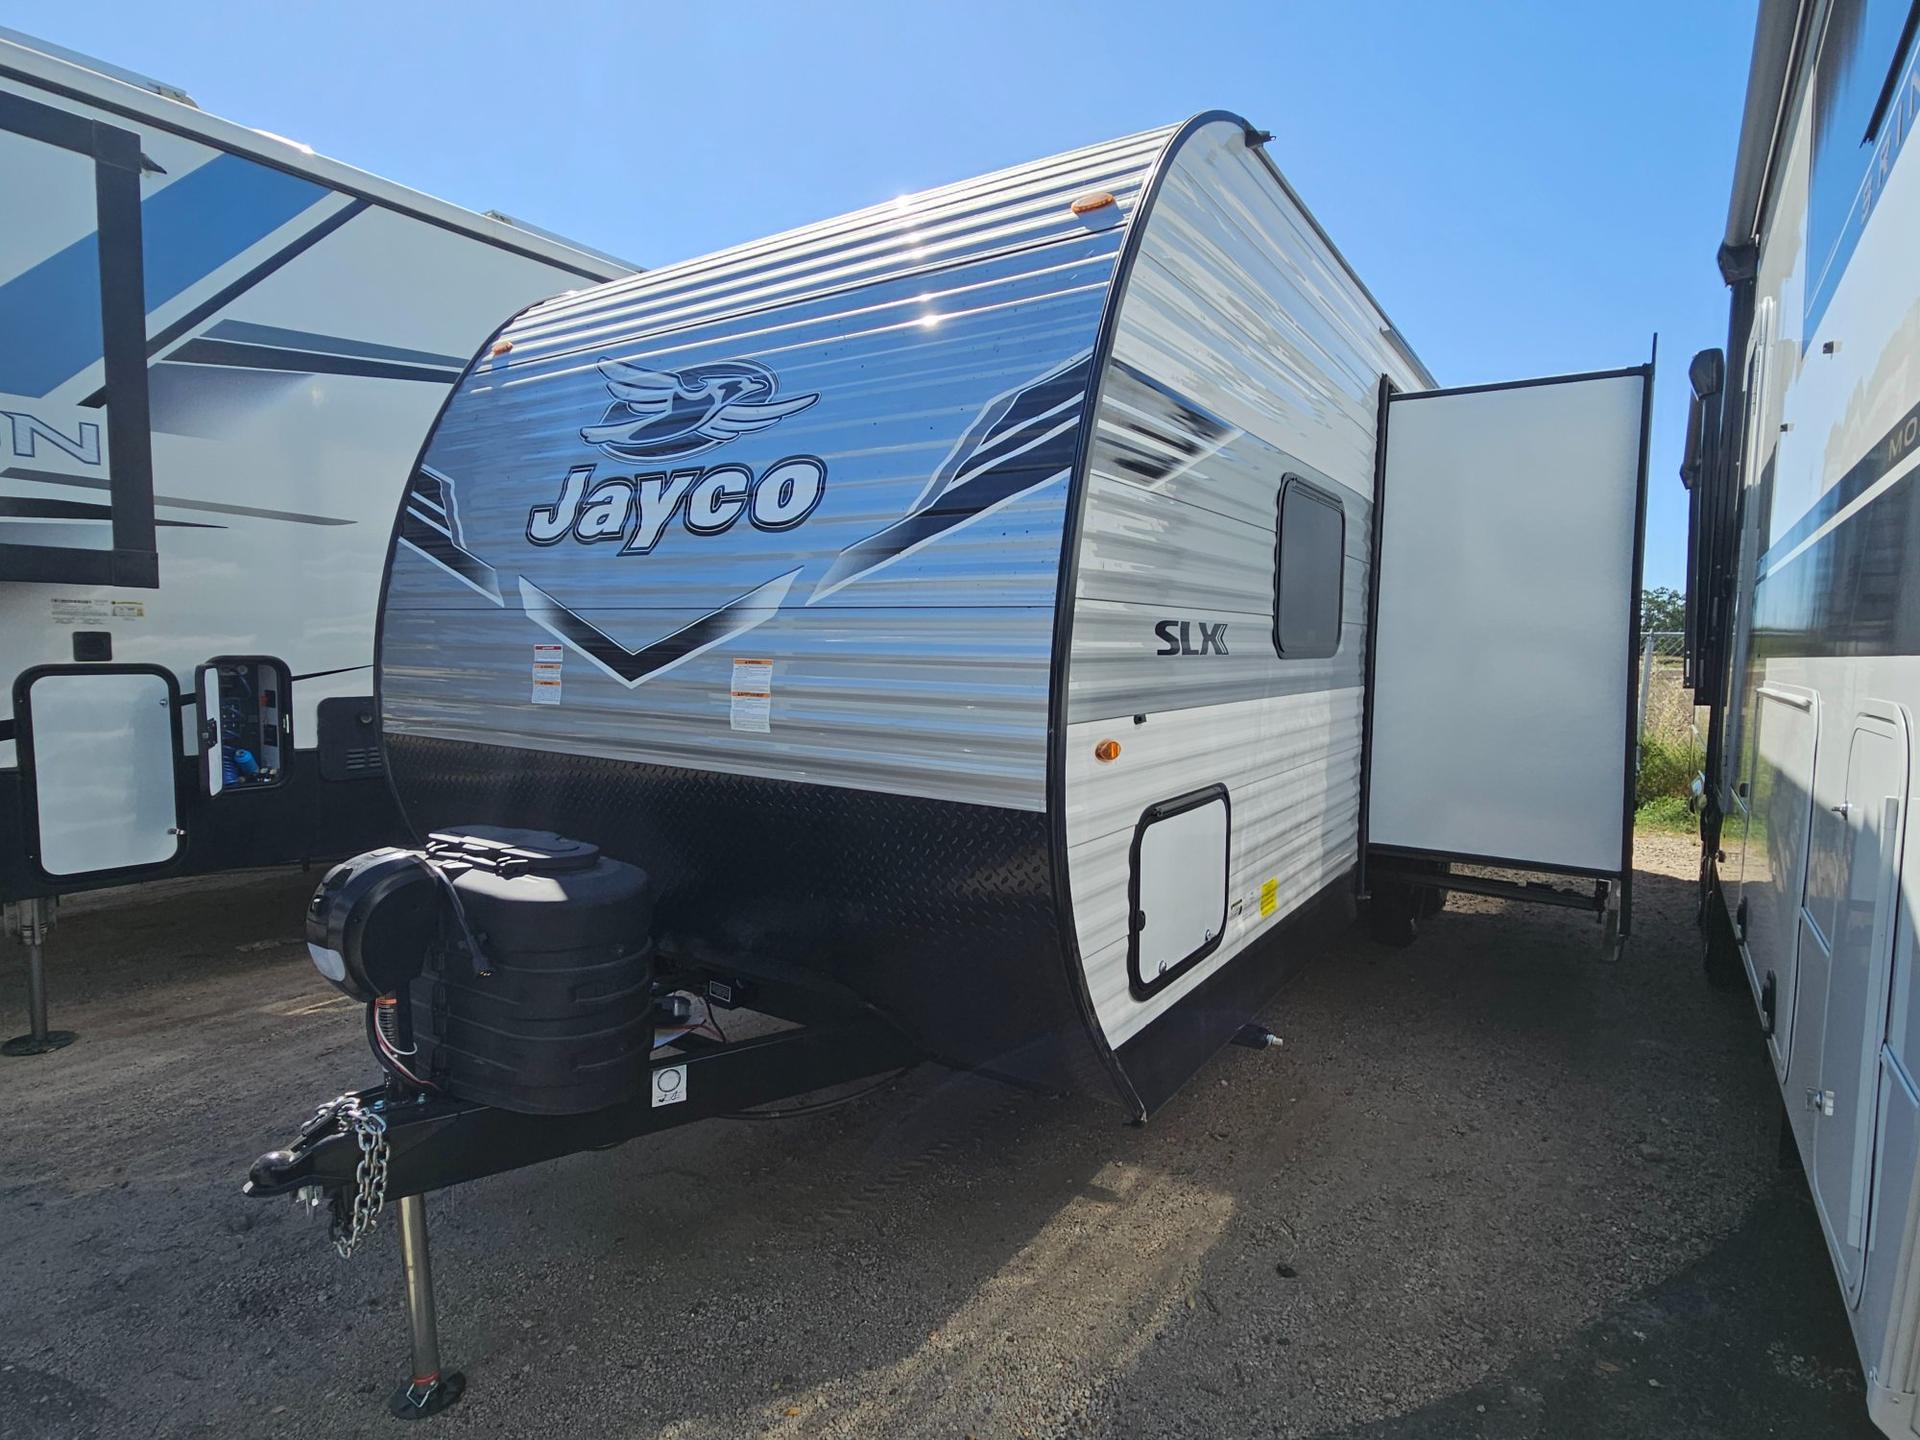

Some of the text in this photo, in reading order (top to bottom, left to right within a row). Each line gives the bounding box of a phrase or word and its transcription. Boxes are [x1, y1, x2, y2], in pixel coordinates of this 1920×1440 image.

[0, 410, 101, 466] N
[526, 455, 828, 557] Jayco
[1155, 620, 1229, 655] SLX
